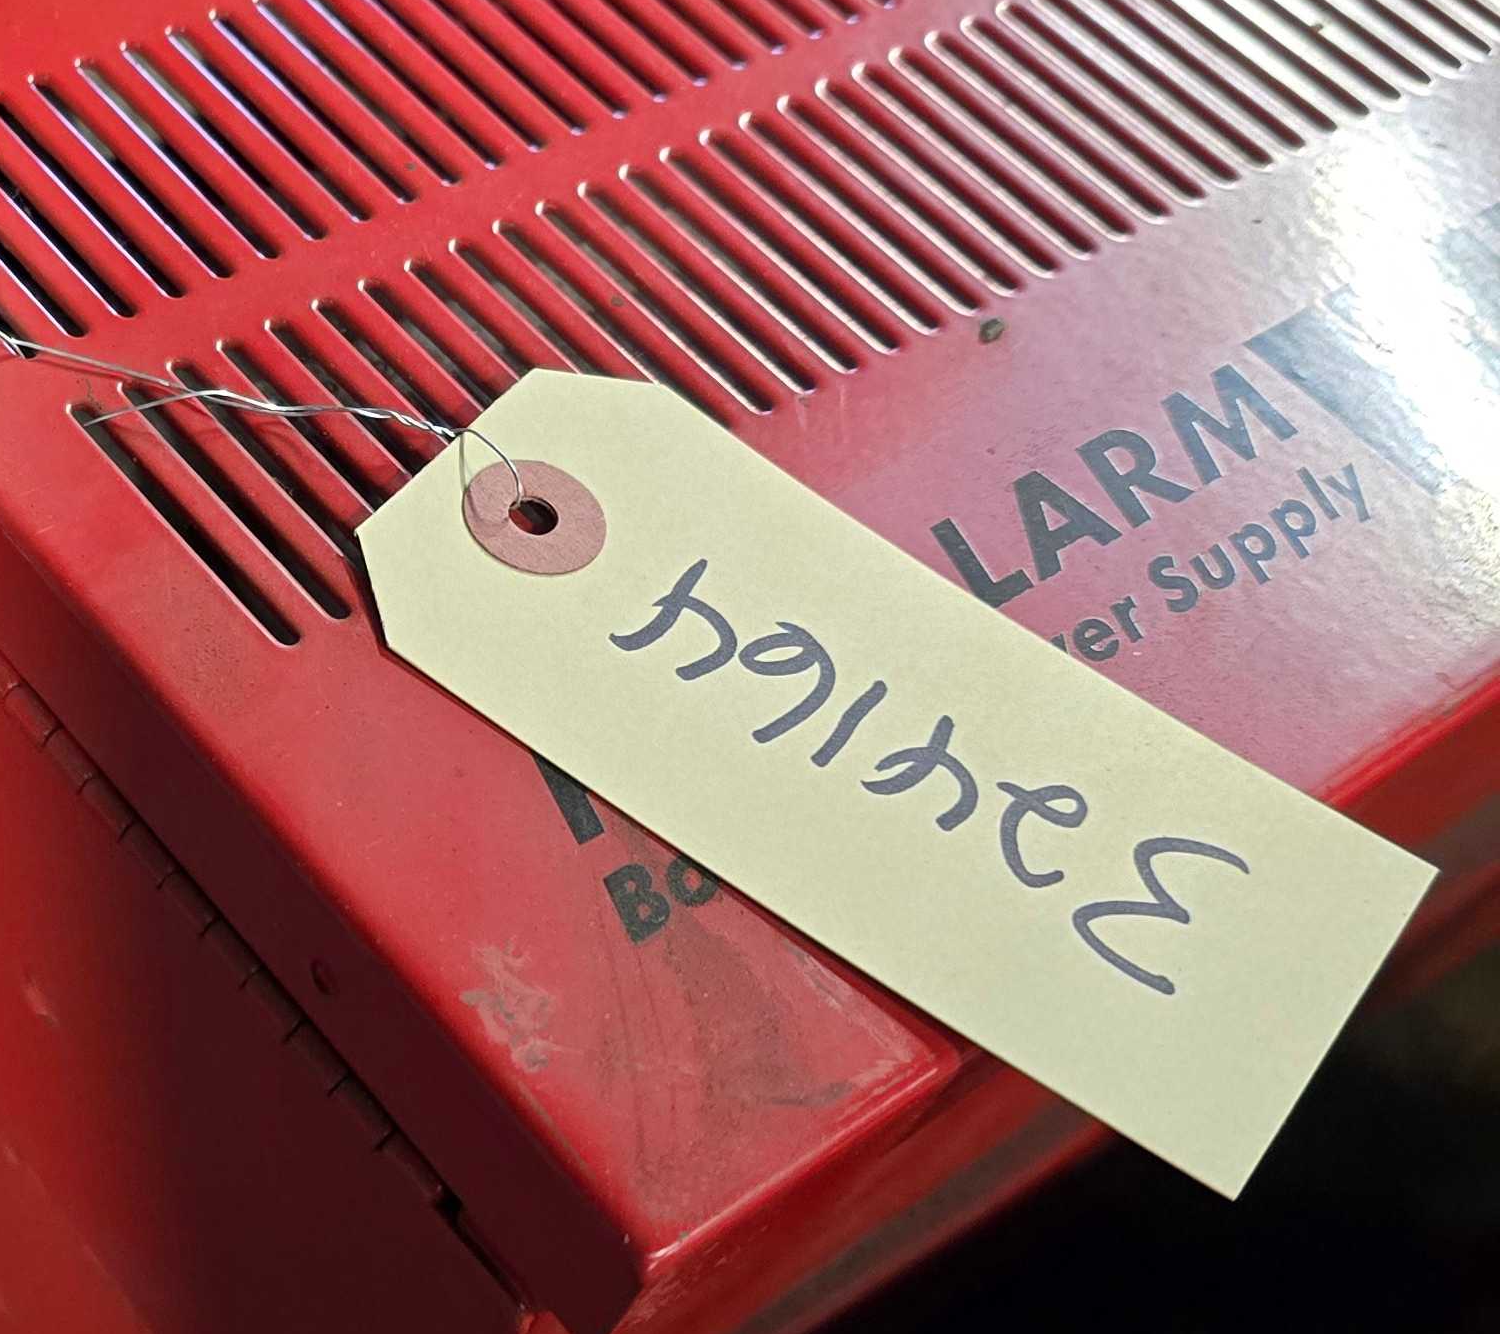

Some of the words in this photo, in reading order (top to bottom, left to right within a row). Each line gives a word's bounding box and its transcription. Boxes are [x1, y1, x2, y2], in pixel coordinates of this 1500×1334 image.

[929, 364, 1299, 608] LARM
[1147, 463, 1370, 613] Supply
[610, 559, 1250, 996] 324164
